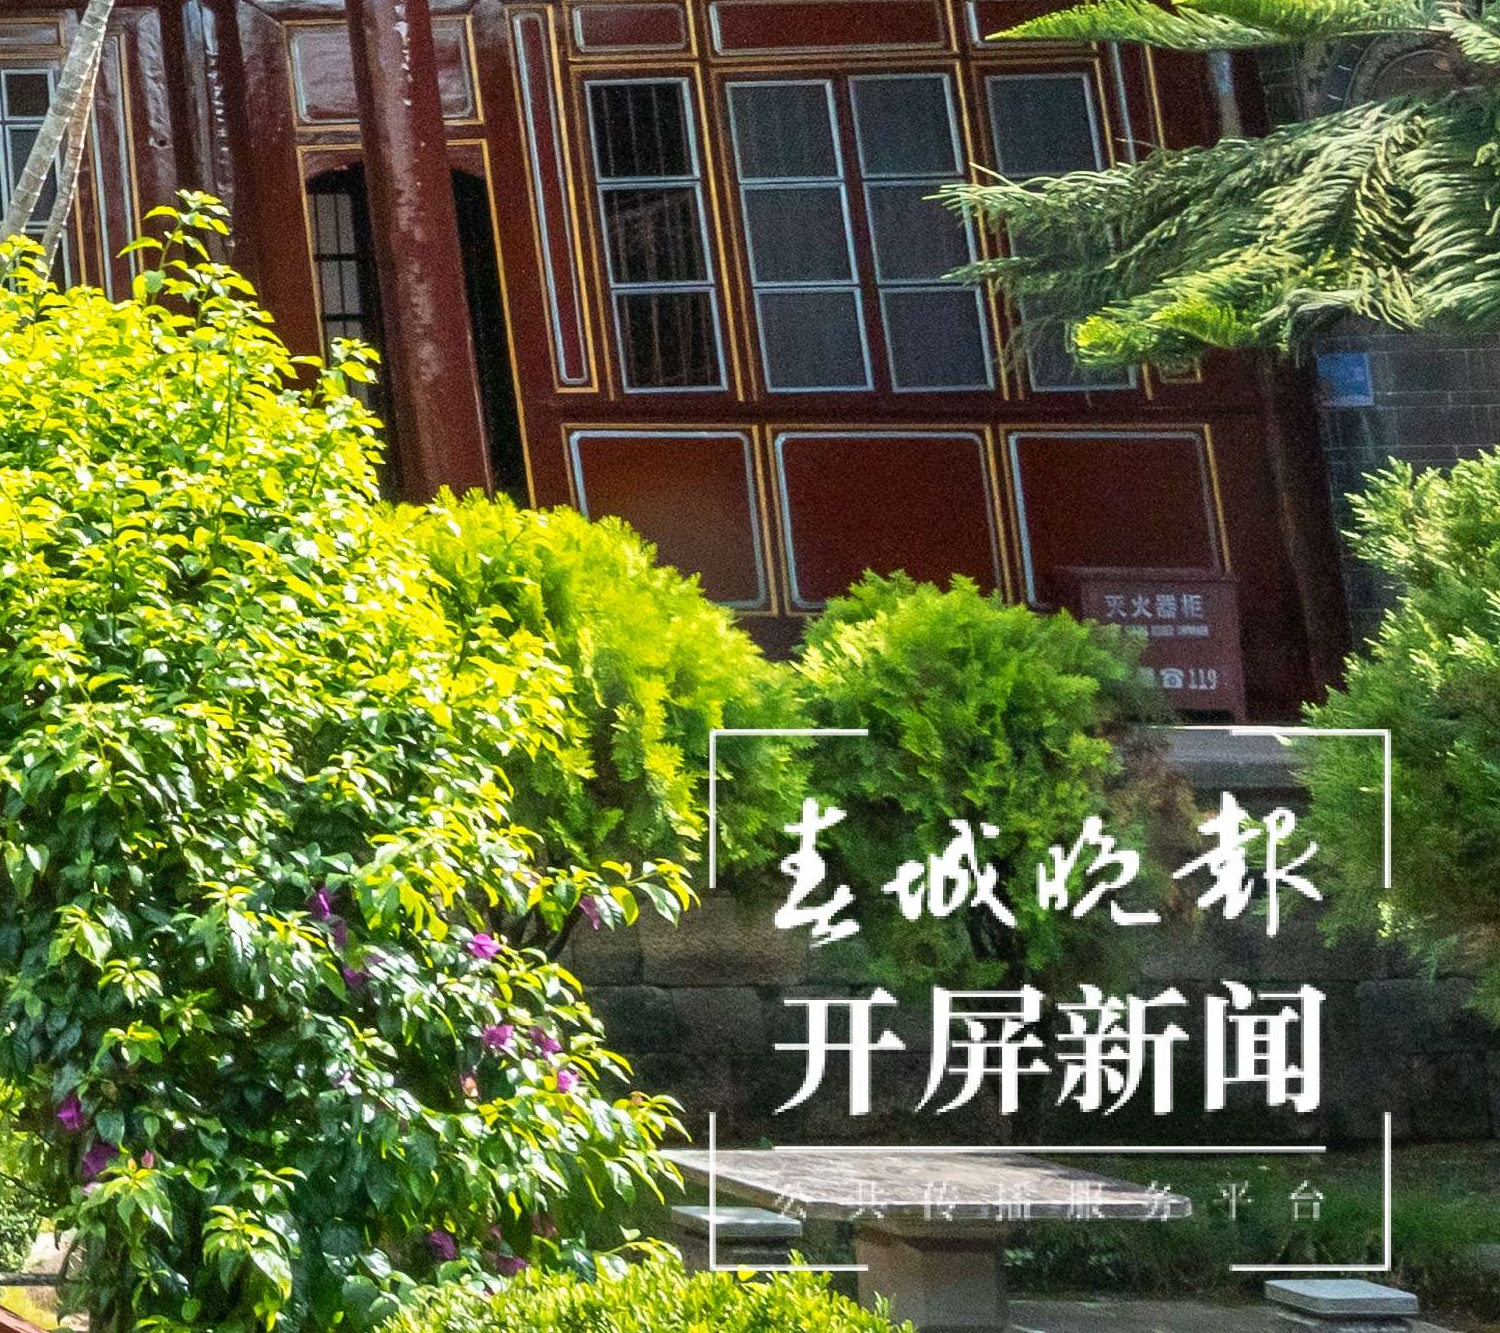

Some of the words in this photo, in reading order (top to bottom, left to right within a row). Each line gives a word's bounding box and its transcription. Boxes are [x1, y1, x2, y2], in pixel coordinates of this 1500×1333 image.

[1104, 594, 1204, 619] 灭火器柜
[1188, 667, 1217, 689] 119
